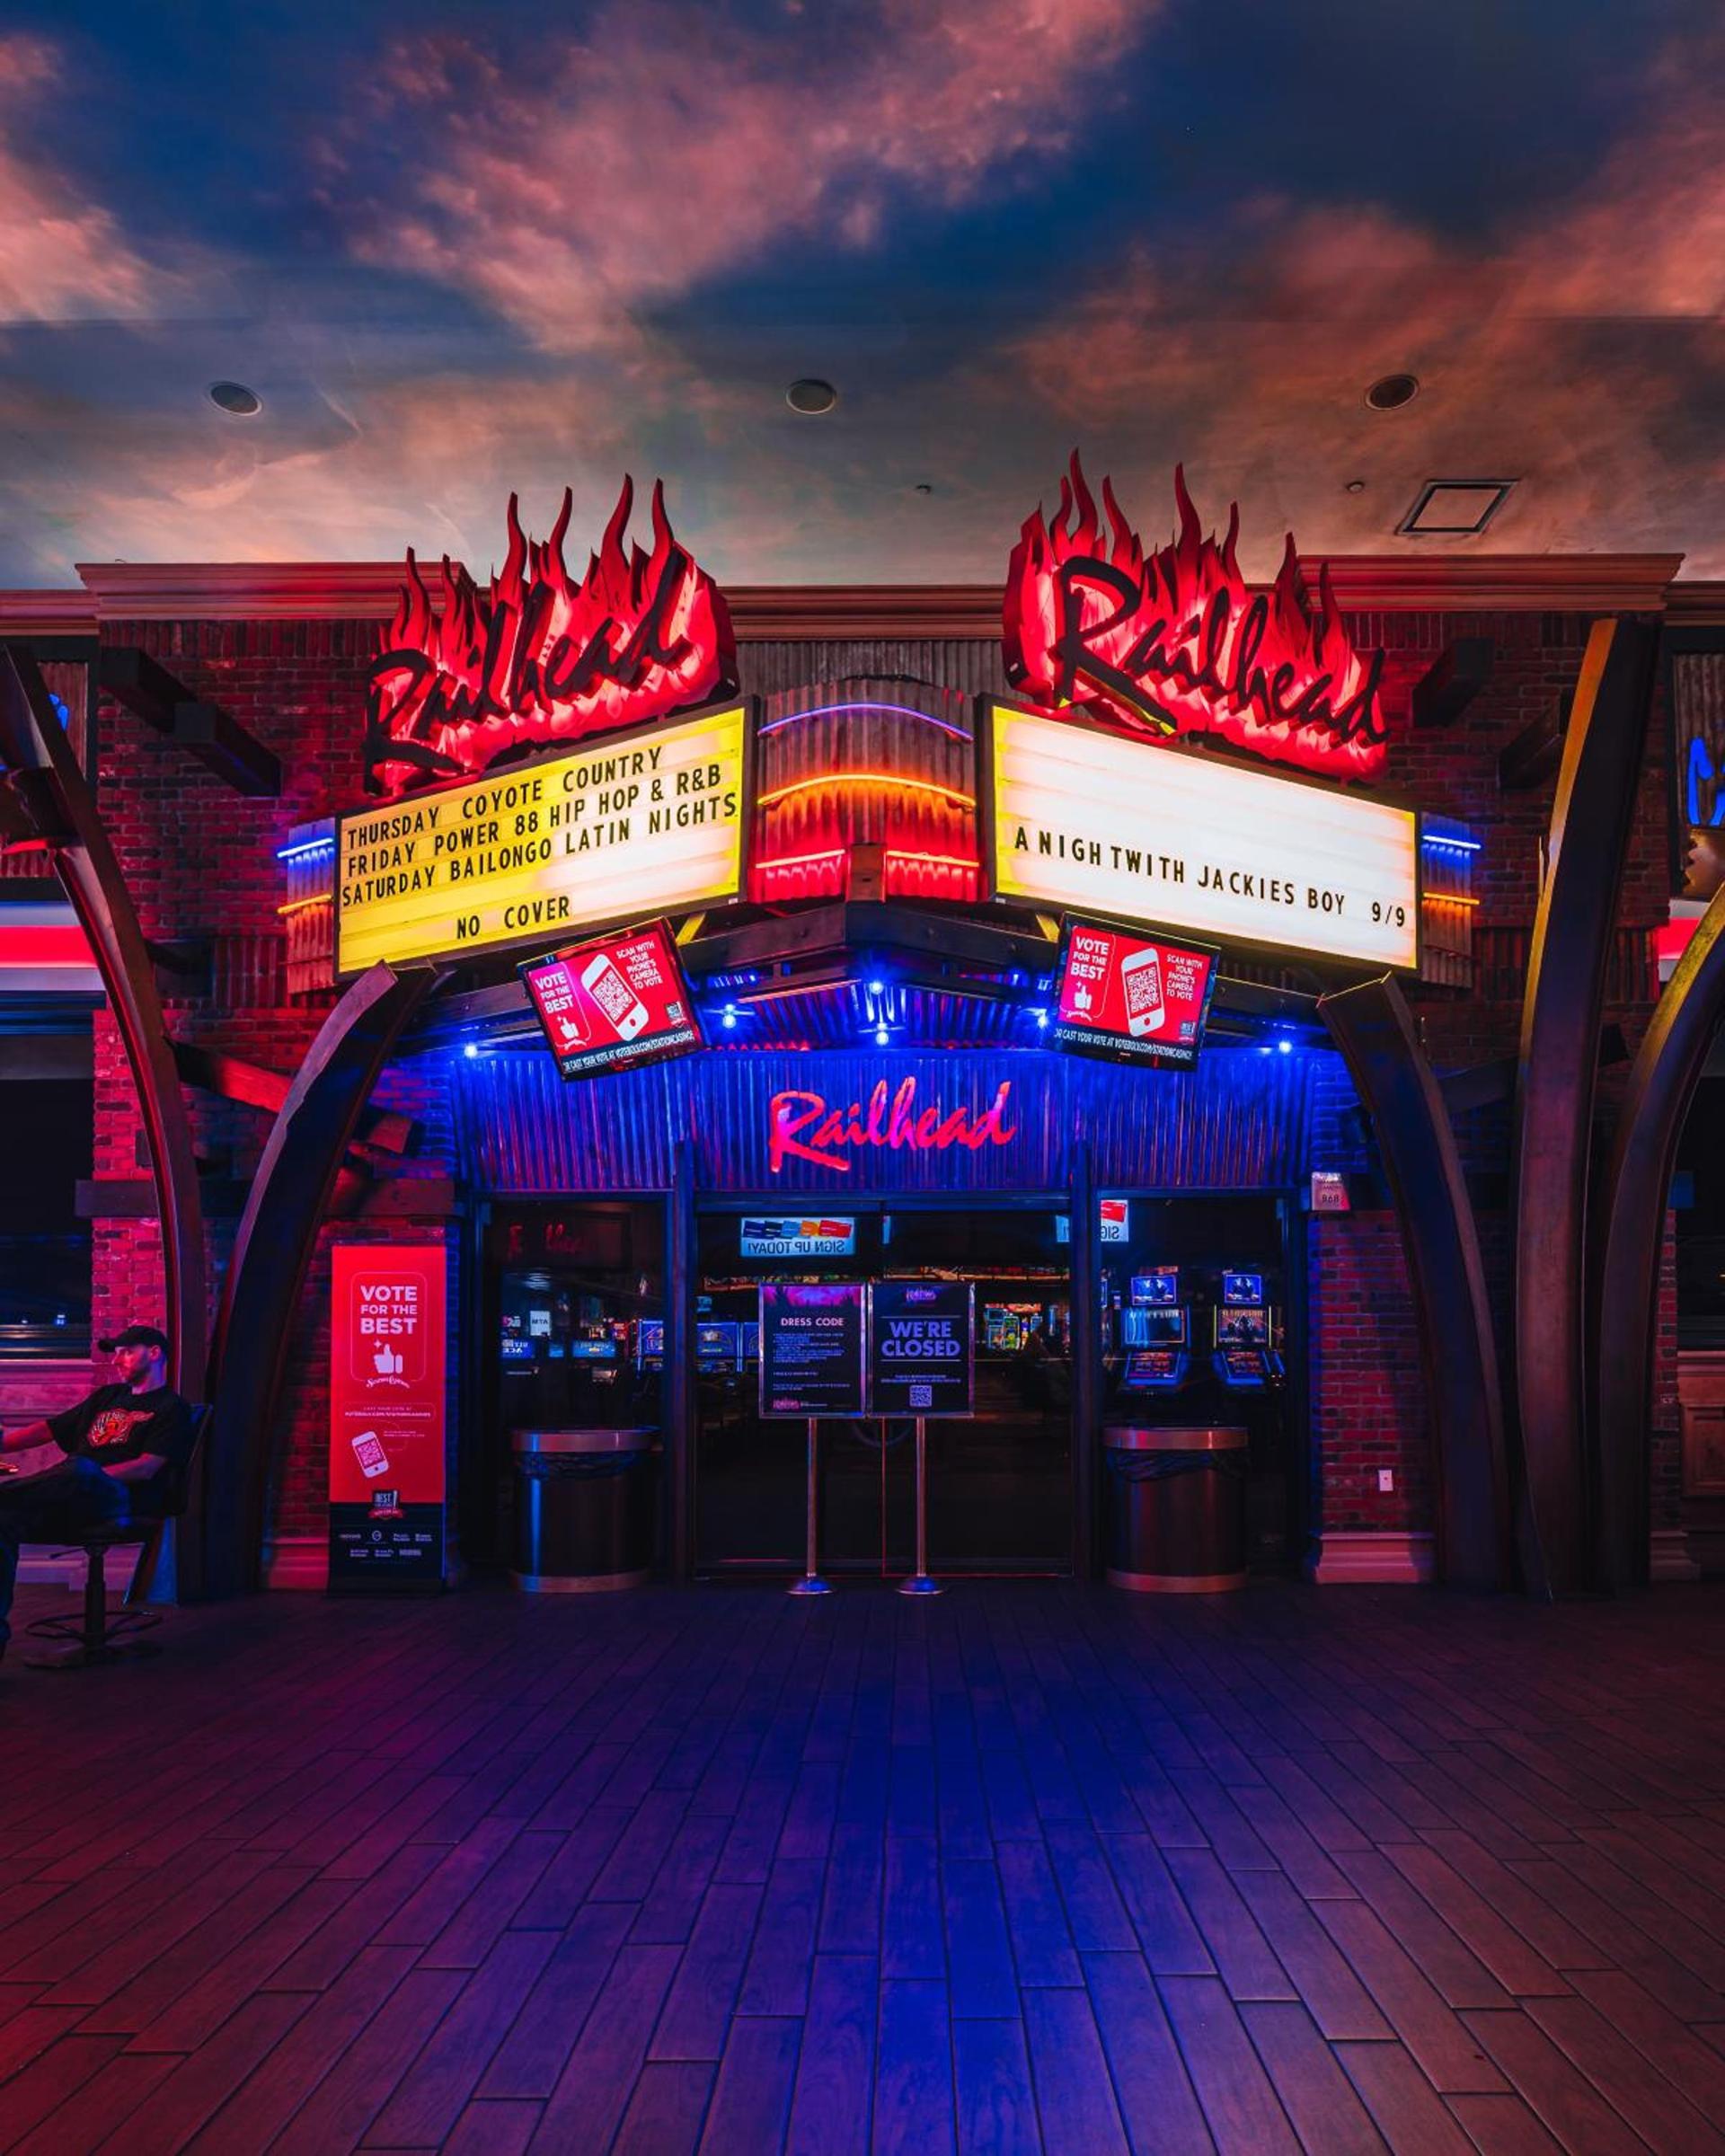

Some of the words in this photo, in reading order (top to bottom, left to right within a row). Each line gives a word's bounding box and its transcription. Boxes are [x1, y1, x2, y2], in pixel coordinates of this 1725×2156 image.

[1048, 554, 1390, 745] Railhead
[360, 551, 690, 797] Railhead
[348, 806, 439, 850] THURSDAY
[463, 779, 543, 819] COYOTE
[562, 747, 662, 792] COUNTRY
[349, 842, 415, 878] FRIDAY
[435, 821, 499, 855] POWER
[515, 811, 538, 835] 88
[550, 799, 585, 827] HIP
[598, 784, 639, 815] HOP
[650, 779, 664, 801] &
[677, 764, 721, 795] R&B
[342, 865, 435, 906] SATURDAY
[450, 838, 552, 881] BAILONGO
[565, 817, 630, 853] LATIN
[649, 791, 737, 835] NIGHTS
[1014, 826, 1029, 851] A
[1198, 865, 1295, 905] JACKIES
[1308, 888, 1345, 915] BOY
[1372, 902, 1405, 927] 9/9
[456, 915, 480, 940] NO
[504, 895, 570, 929] COVER
[616, 946, 635, 959] SCAN
[1075, 936, 1110, 954] VOTE
[629, 951, 649, 963] YOUR
[1073, 952, 1090, 962] FOR
[1092, 956, 1107, 966] THE
[1167, 954, 1185, 965] SCAN
[1070, 962, 1106, 980] BEST
[1175, 965, 1194, 975] YOUR
[535, 972, 567, 990] VOTE
[633, 980, 643, 990] TO
[643, 976, 663, 987] VOTE
[541, 988, 556, 1000] FOR
[556, 985, 571, 996] THE
[1166, 988, 1175, 996] TO
[1177, 991, 1194, 1002] VOTE
[544, 995, 575, 1014] BEST
[769, 1076, 1017, 1171] Railhead
[360, 1286, 418, 1302] VOTE
[361, 1304, 388, 1314] FOR
[391, 1304, 417, 1314] THE
[360, 1317, 418, 1335] BEST
[781, 1317, 812, 1326] DRESS
[815, 1317, 845, 1326] CODE
[889, 1321, 951, 1338] WE'RE
[881, 1339, 960, 1356] CLOSED
